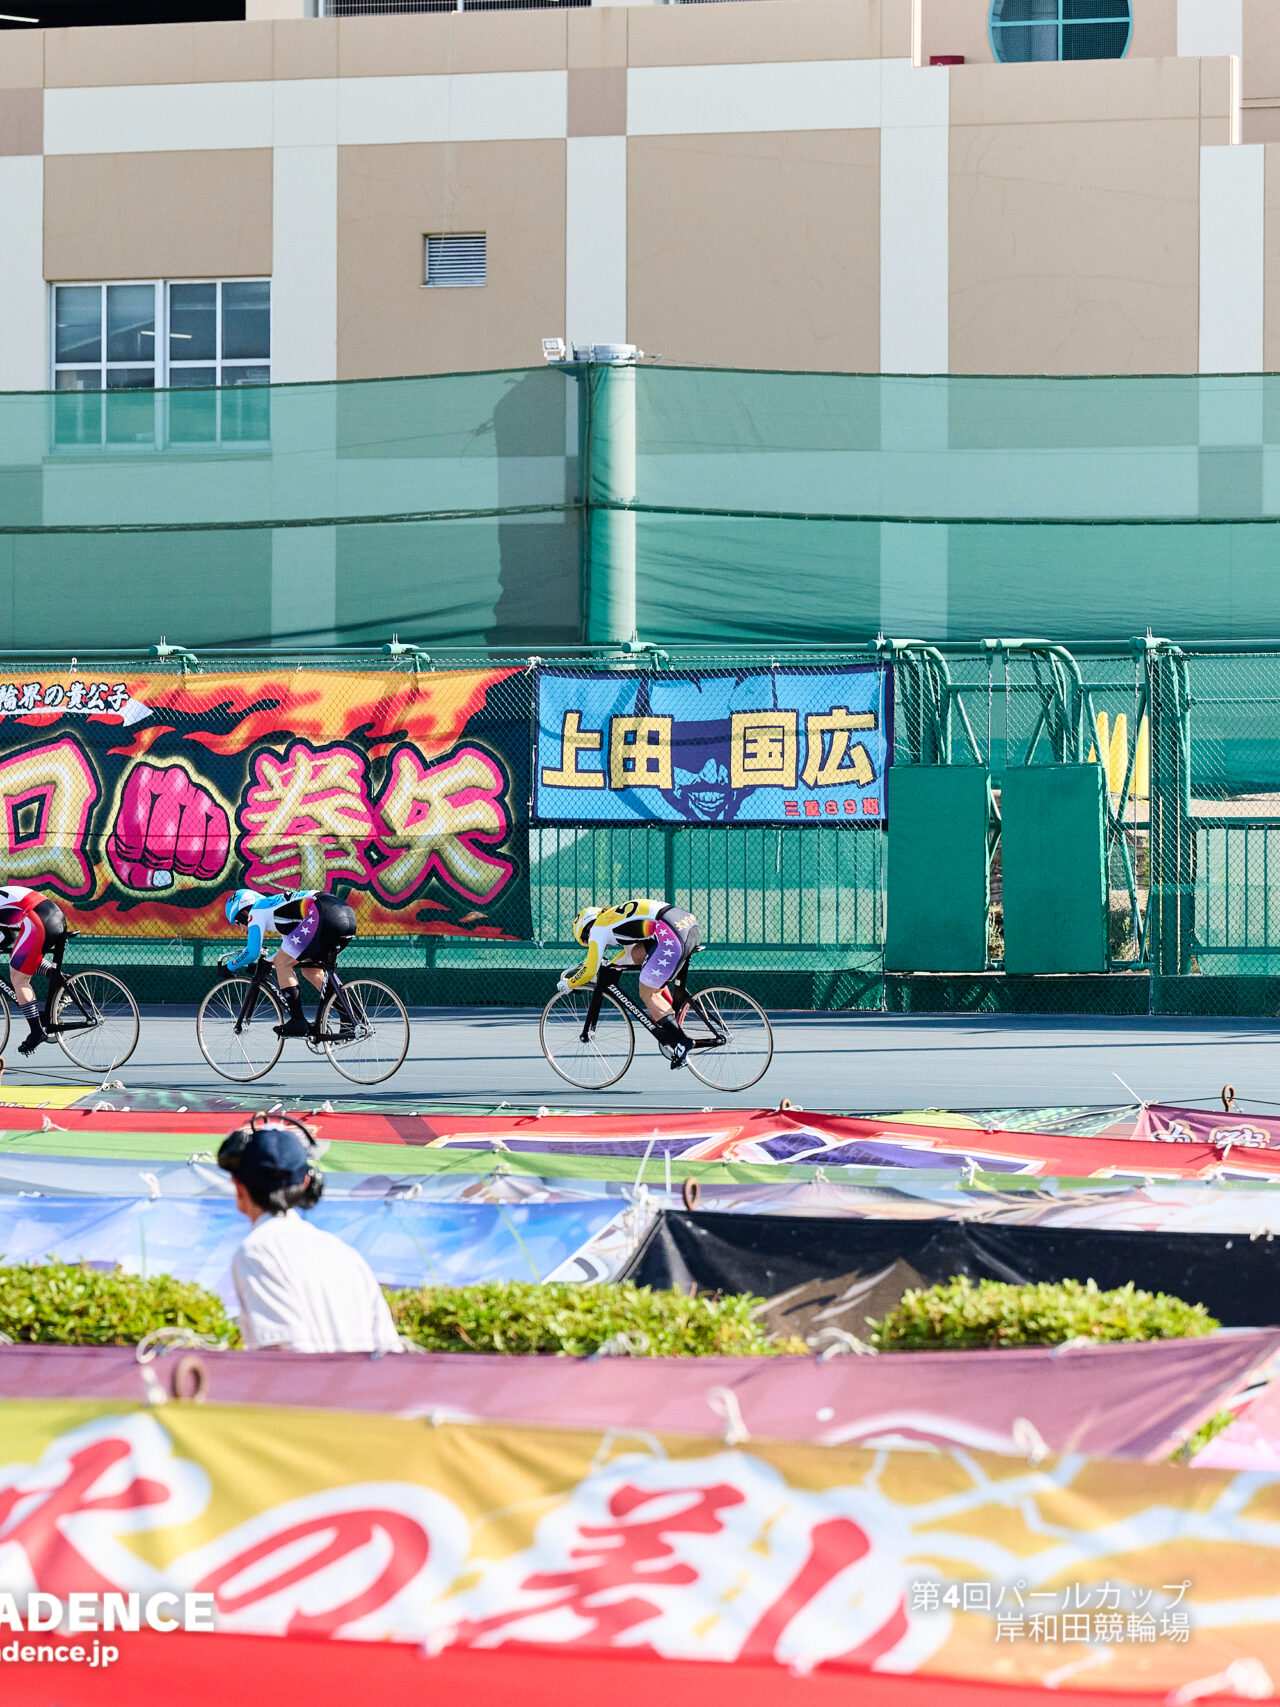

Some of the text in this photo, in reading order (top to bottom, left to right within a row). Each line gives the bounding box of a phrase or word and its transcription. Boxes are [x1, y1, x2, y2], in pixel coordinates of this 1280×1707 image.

[541, 705, 877, 790] 上田 国広
[607, 984, 656, 1032] BRIDGESTONE
